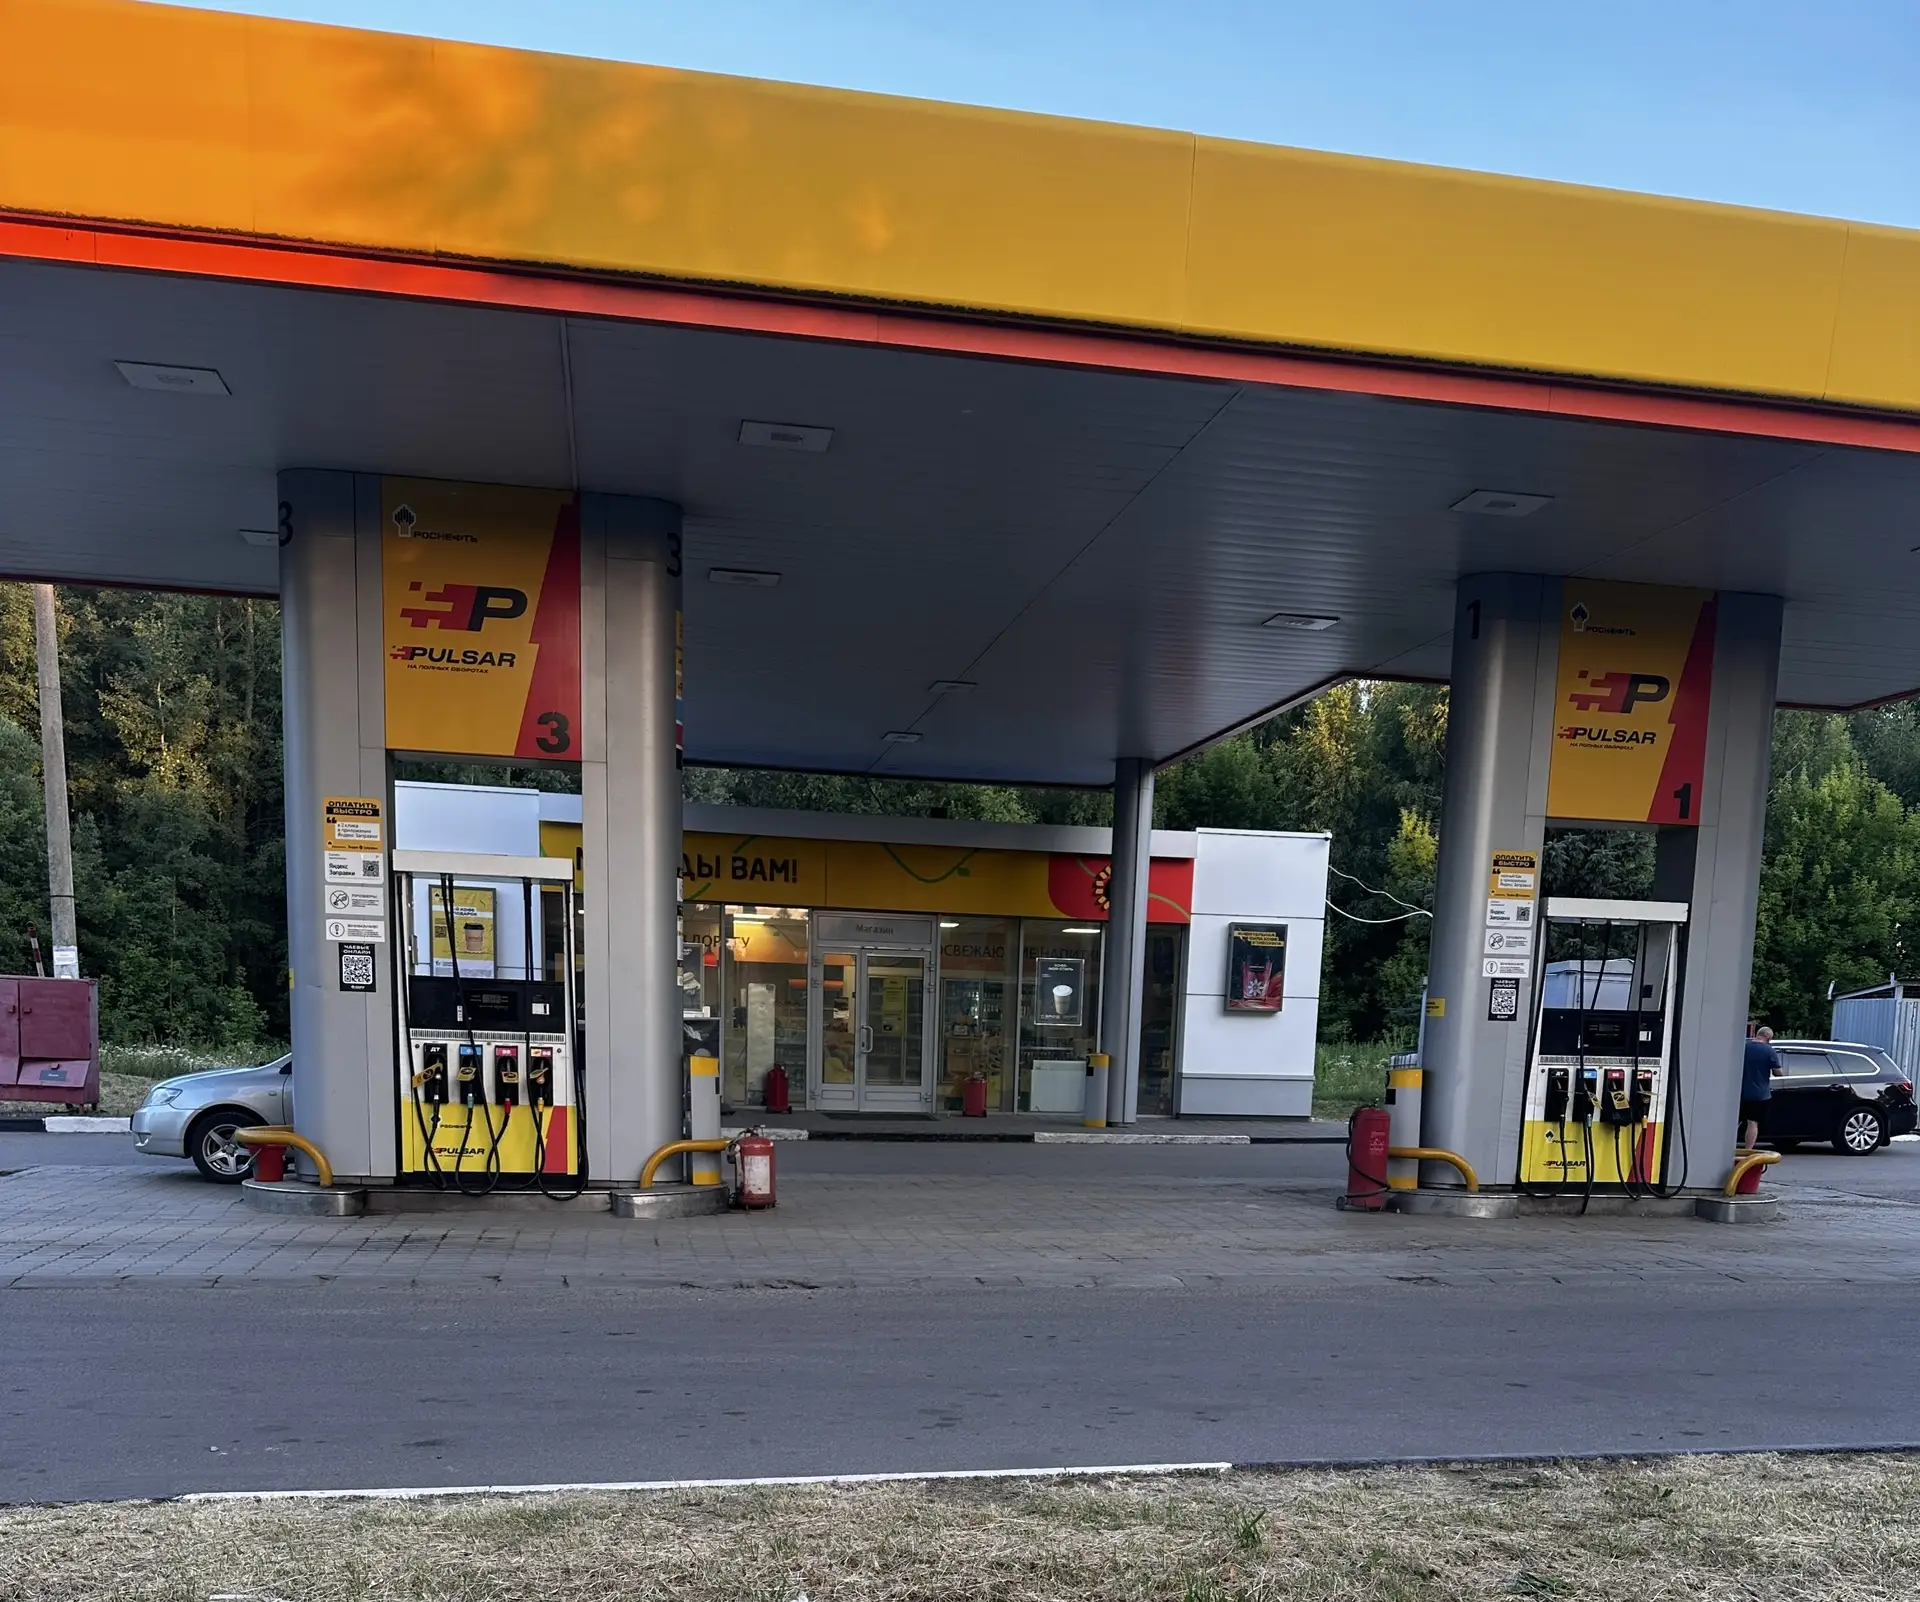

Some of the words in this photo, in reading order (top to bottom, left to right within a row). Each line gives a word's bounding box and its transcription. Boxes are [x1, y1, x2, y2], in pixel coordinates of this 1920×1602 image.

[279, 501, 293, 547] 3
[413, 530, 479, 543] РОСНЕФТЬ
[666, 532, 681, 577] 3
[1467, 599, 1481, 639] 1
[1585, 626, 1636, 636] РОСНЕФТЬ
[409, 646, 516, 668] PULSAR
[536, 711, 570, 754] 3
[1573, 727, 1656, 745] PULSAR
[1673, 783, 1691, 818] 1
[731, 856, 797, 883] ВАМ!
[856, 924, 894, 934] Магазин
